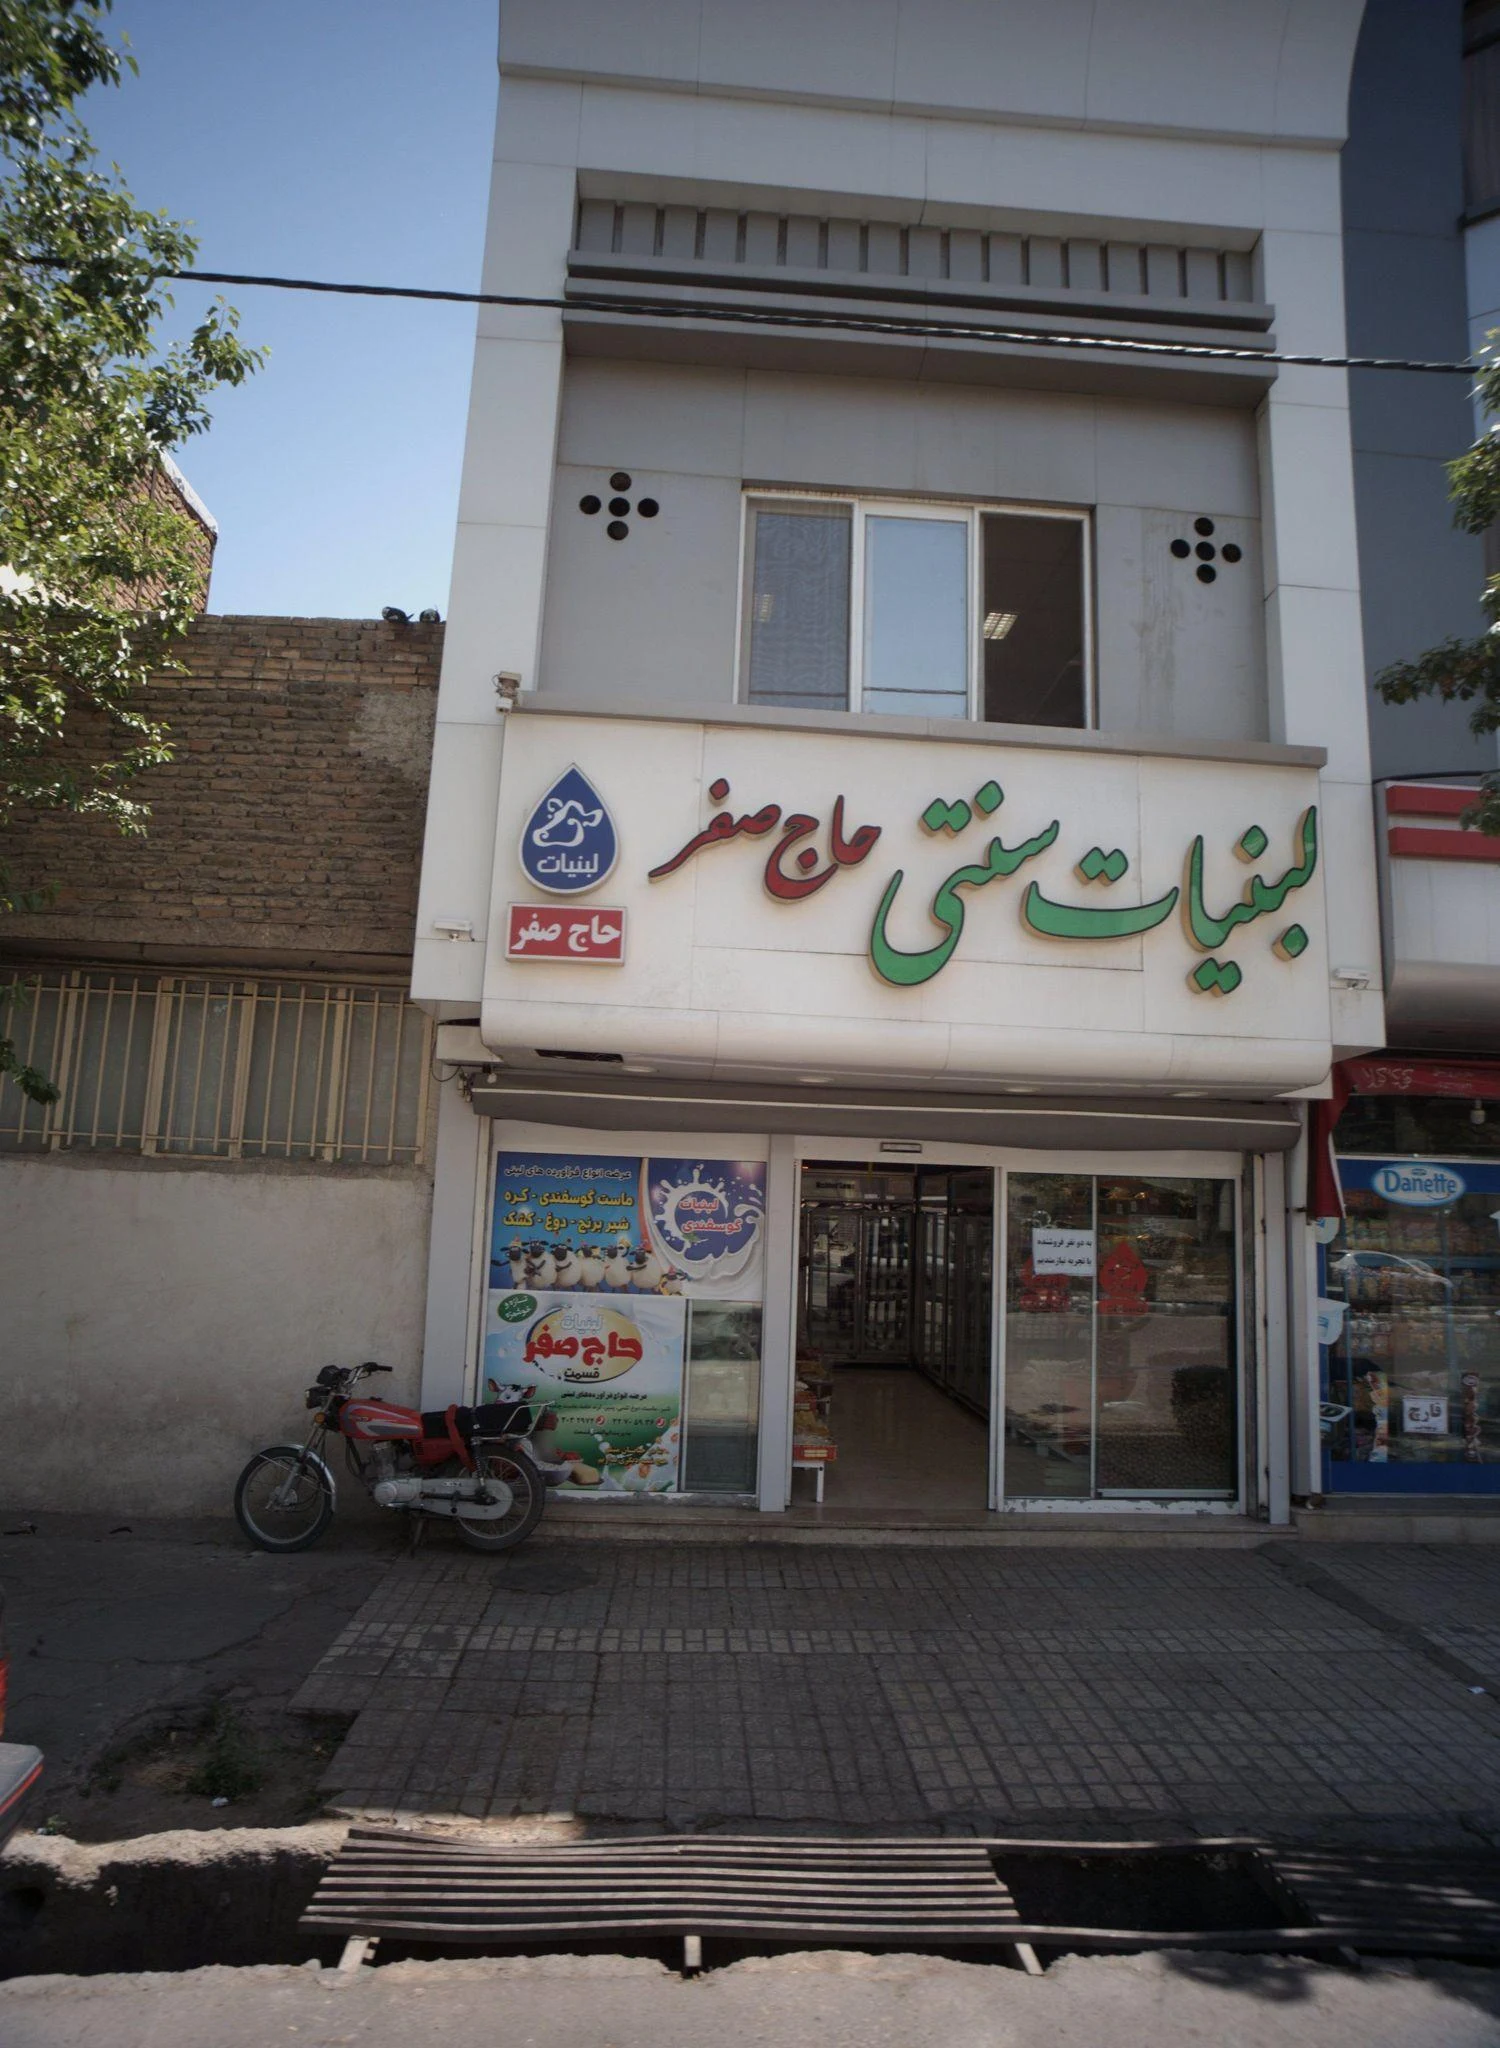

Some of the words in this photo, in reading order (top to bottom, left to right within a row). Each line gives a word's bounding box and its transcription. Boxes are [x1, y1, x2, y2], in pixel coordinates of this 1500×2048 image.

[647, 777, 783, 879] صفر
[765, 793, 883, 901] حاج
[536, 852, 600, 878] لبنیات
[868, 779, 1061, 987] سنتی
[1018, 805, 1318, 995] لبنیات
[510, 911, 563, 951] صفر
[567, 914, 621, 952] حاج
[504, 1163, 525, 1178] لبنی
[526, 1164, 544, 1178] های
[581, 1167, 604, 1181] انواع
[604, 1170, 632, 1181] عرضه
[1382, 1169, 1458, 1194] Danette
[503, 1188, 529, 1205] کره
[539, 1188, 595, 1208] گوسفندی
[596, 1192, 634, 1207] ماست
[678, 1196, 720, 1214] لبنیات
[502, 1210, 535, 1227] کشک
[544, 1211, 567, 1231] دوغ
[577, 1216, 603, 1234] برنج
[604, 1216, 630, 1234] شیر
[681, 1217, 744, 1236] گوسفندی
[1036, 1238, 1065, 1248] فروشنده
[1066, 1239, 1076, 1248] نفر
[1036, 1256, 1066, 1267] نیازمندیم
[1068, 1258, 1085, 1267] تجربه
[560, 1311, 605, 1334] لبنیات
[523, 1324, 580, 1362] صفر
[581, 1331, 643, 1366] حاج
[563, 1367, 600, 1380] قسمت
